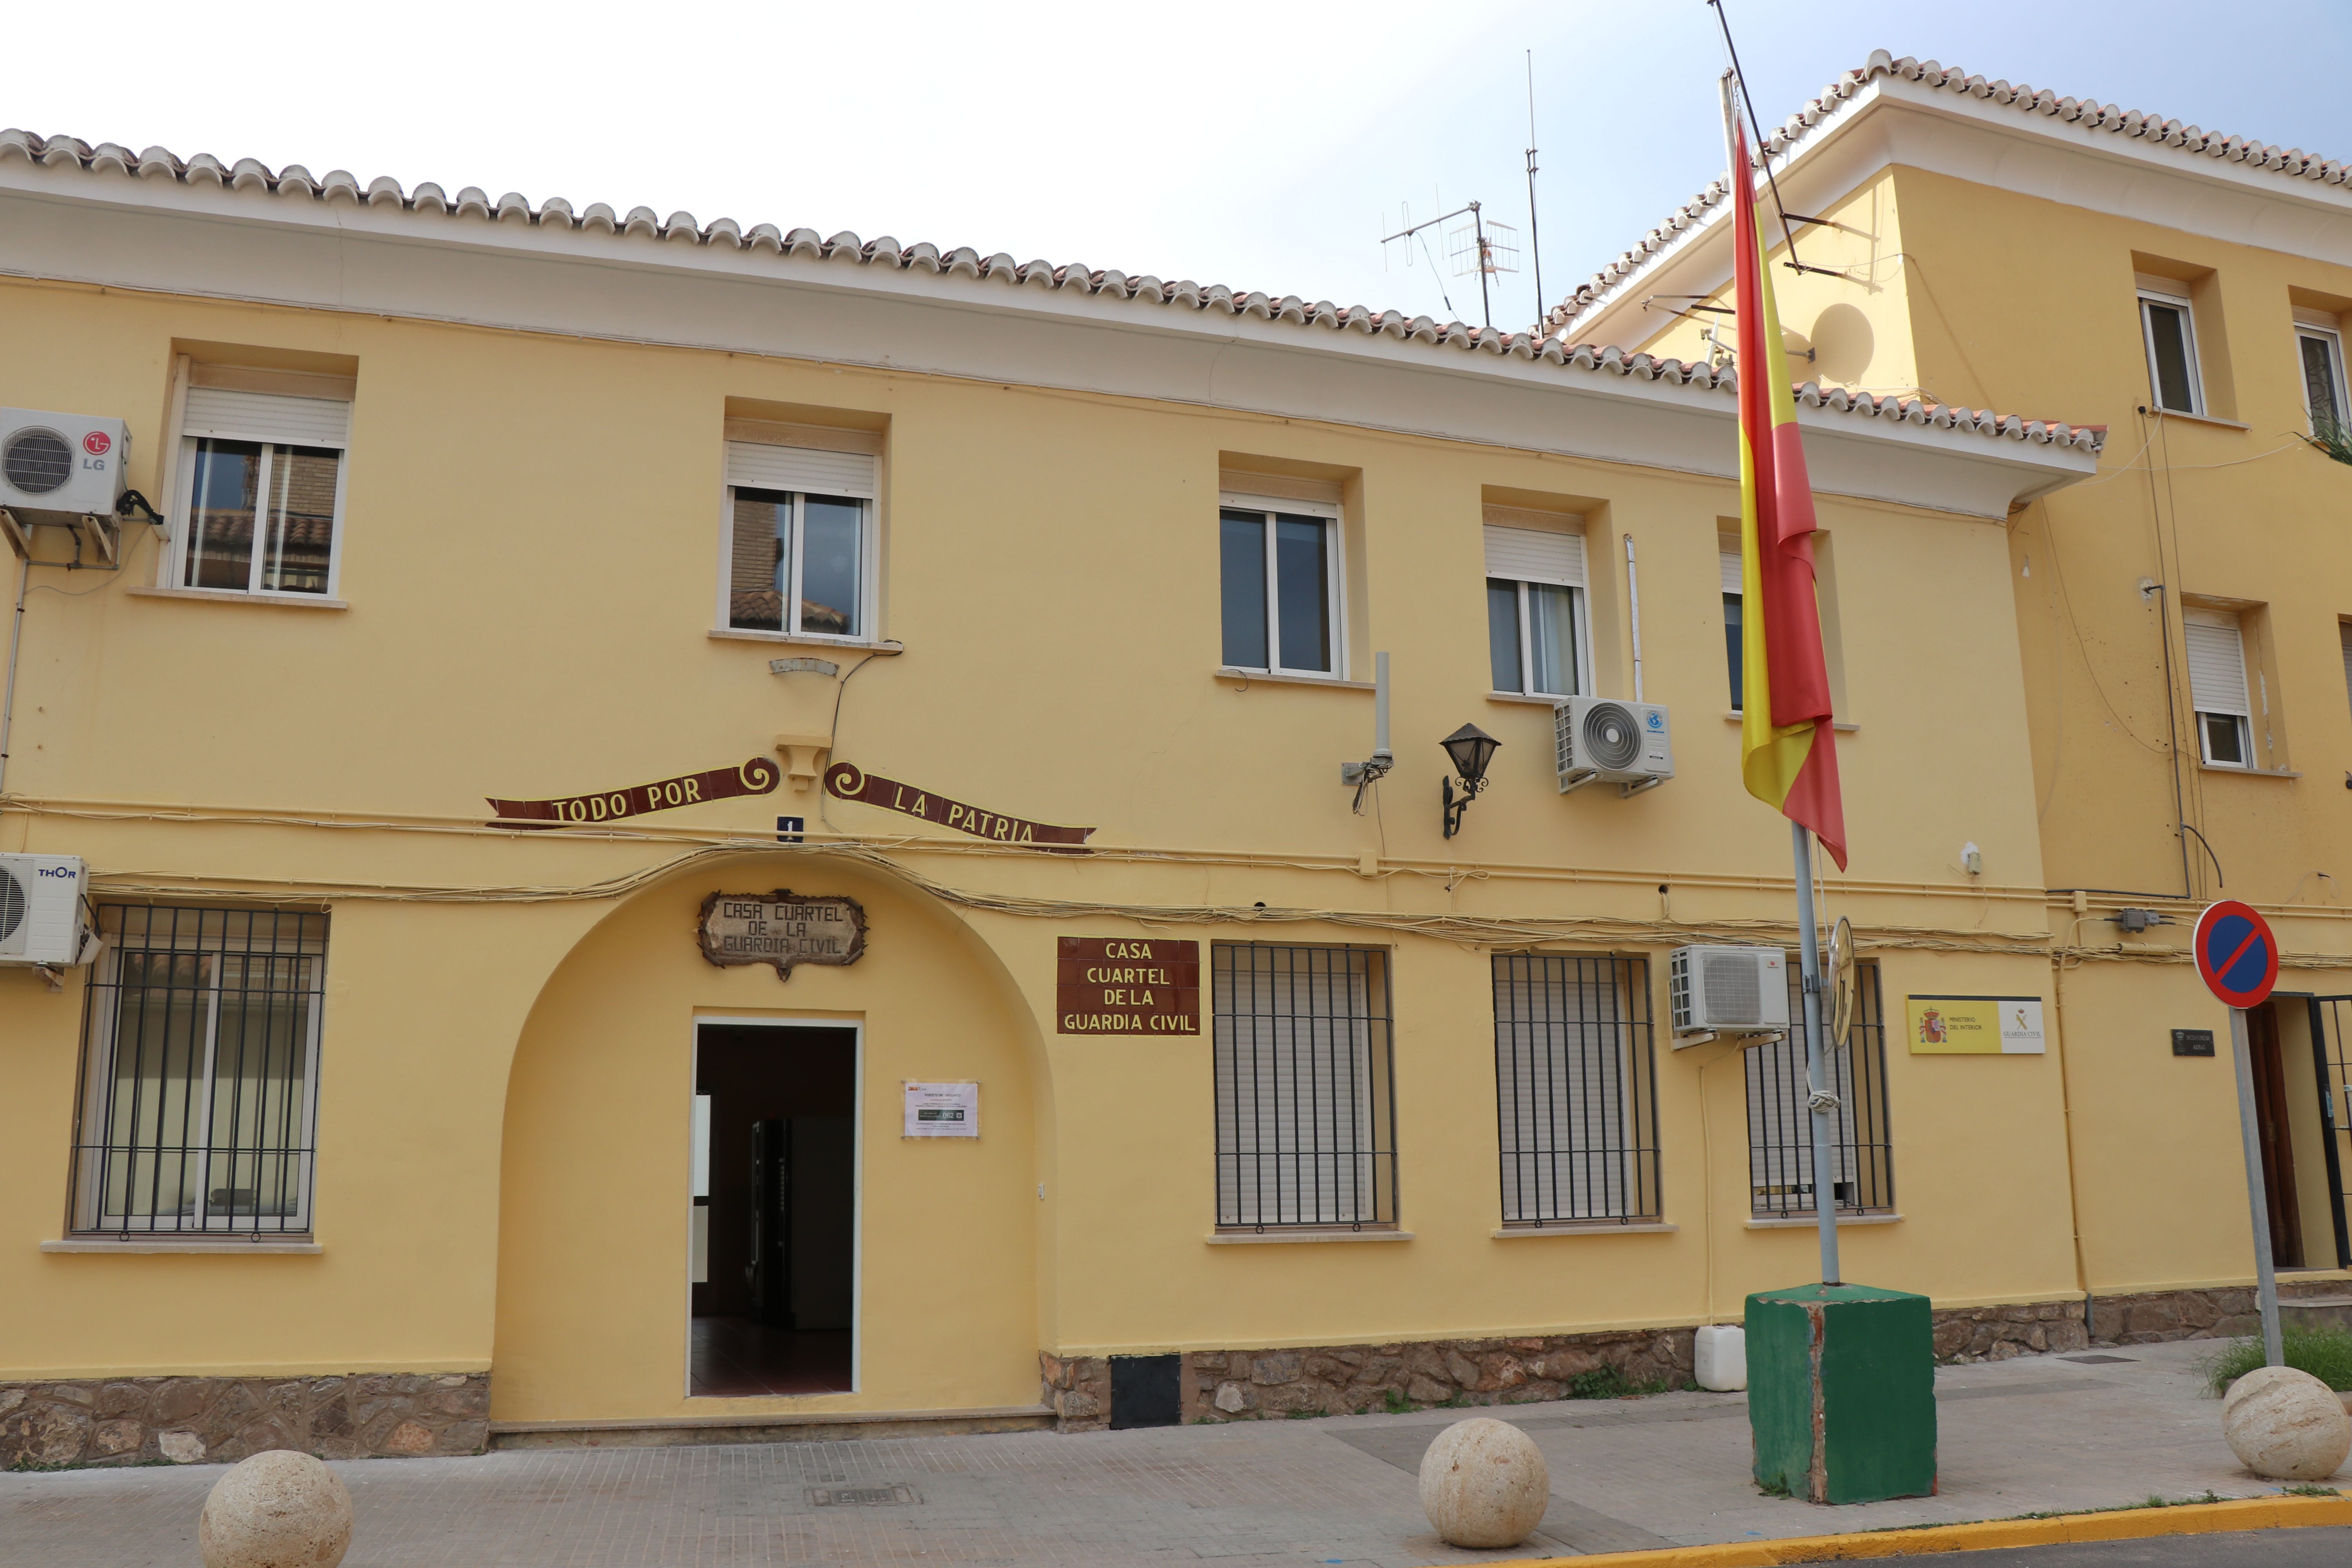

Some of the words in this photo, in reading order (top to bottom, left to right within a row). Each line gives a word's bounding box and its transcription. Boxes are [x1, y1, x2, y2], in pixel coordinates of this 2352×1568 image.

[83, 458, 105, 470] LG
[552, 794, 626, 822] TODO
[647, 778, 702, 809] POR
[894, 786, 926, 817] LA
[948, 804, 1033, 842] PATRIA
[787, 821, 793, 840] 1
[38, 867, 76, 878] THOR
[724, 902, 762, 919] CASA
[775, 905, 843, 922] CUARTEL
[748, 921, 767, 936] DE
[786, 922, 806, 937] LA
[724, 936, 789, 953] GUARDIA
[799, 939, 841, 954] CIVIL
[1105, 943, 1152, 959] CASA
[1087, 968, 1170, 985] CUARTEL
[1104, 989, 1126, 1005] DE
[1130, 990, 1154, 1005] LA
[1064, 1014, 1143, 1030] GUARDIA
[1150, 1015, 1196, 1031] CIVIL
